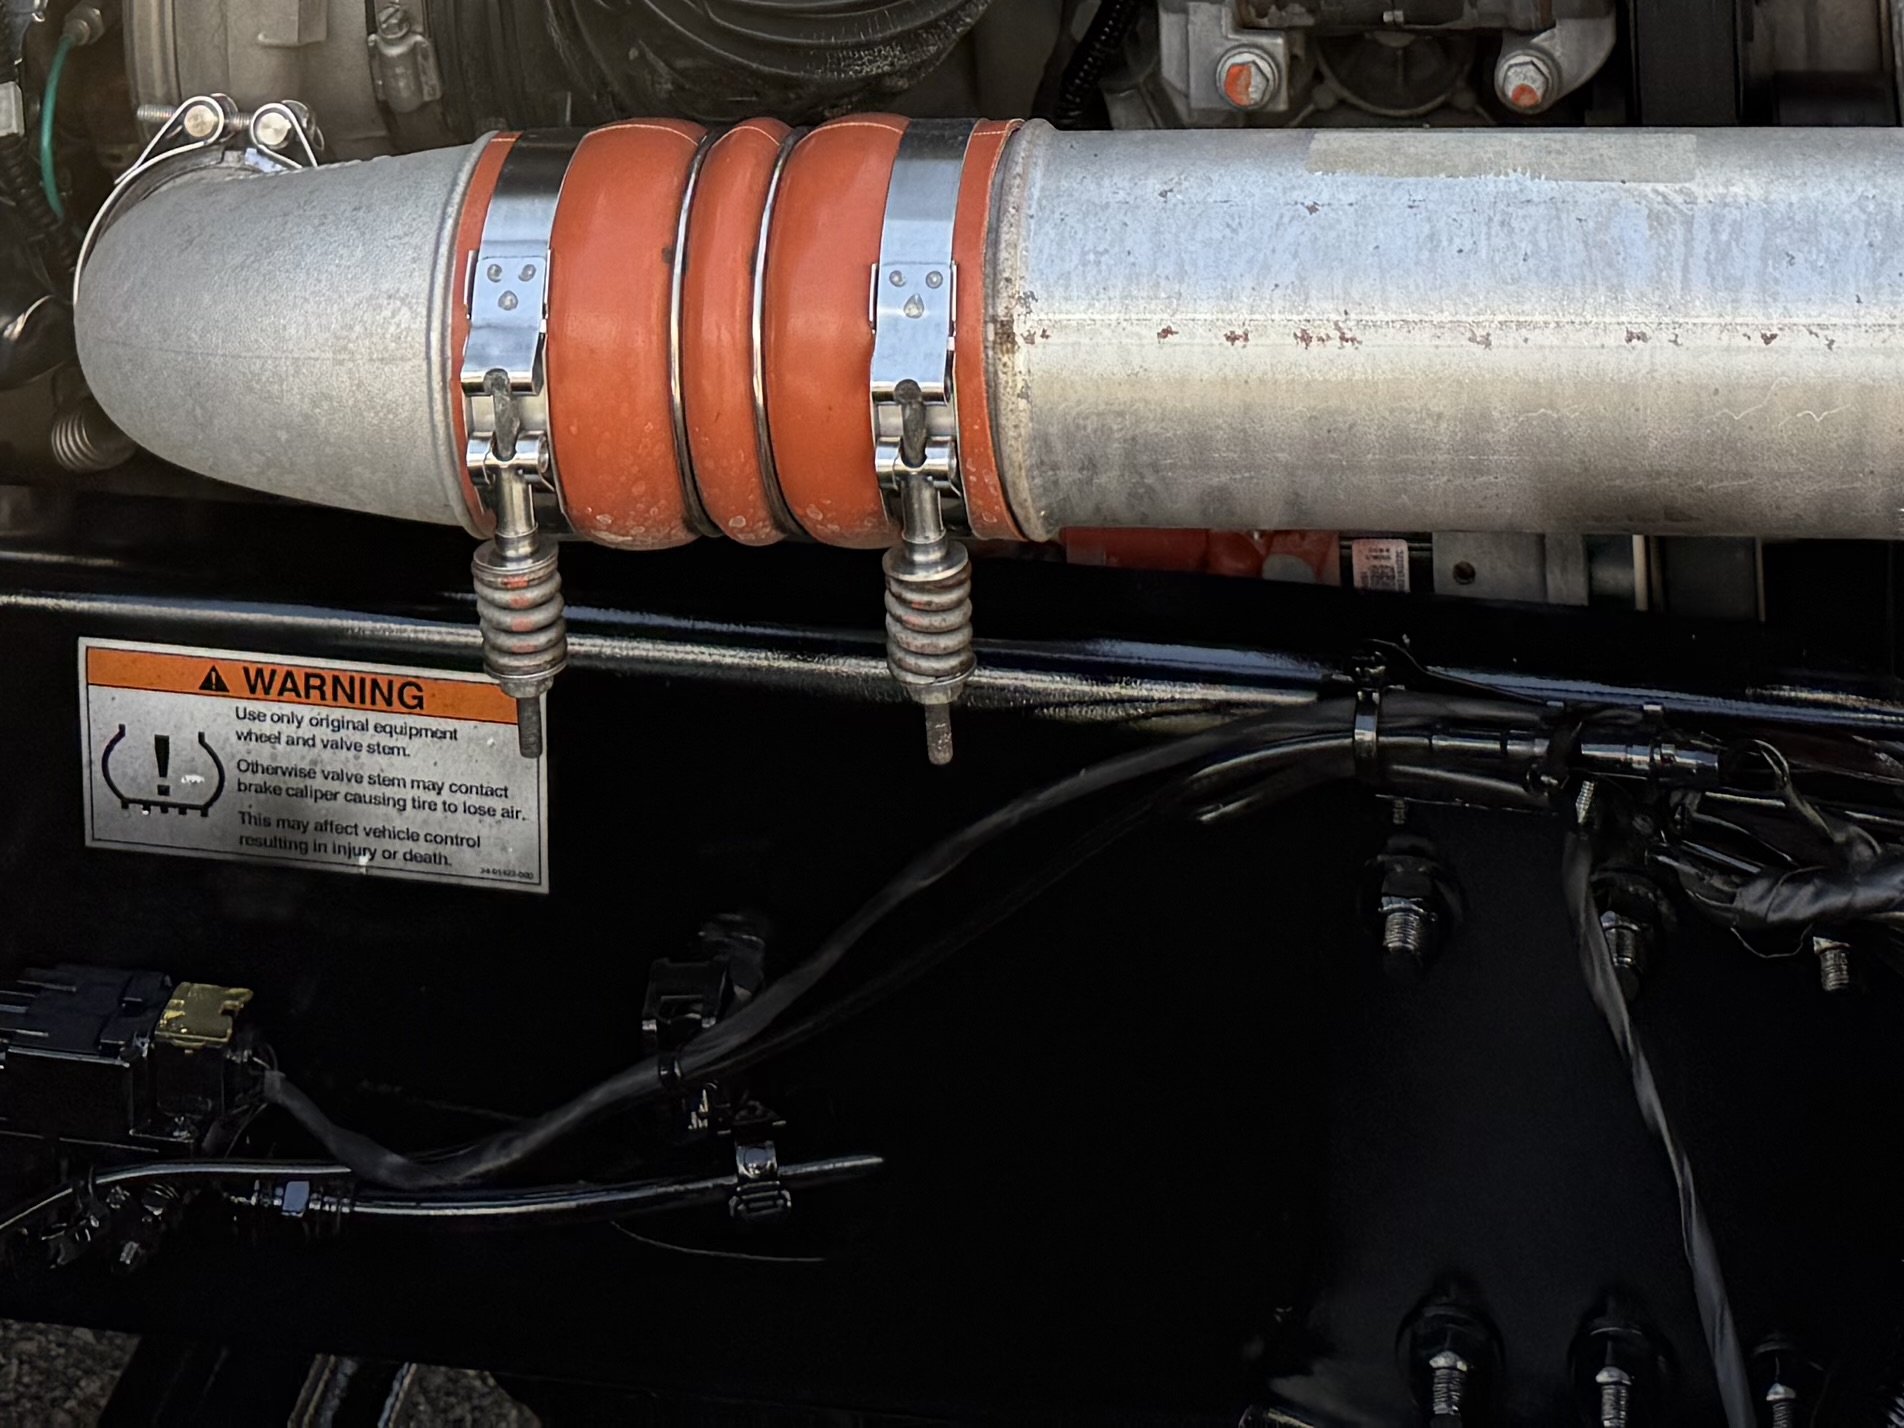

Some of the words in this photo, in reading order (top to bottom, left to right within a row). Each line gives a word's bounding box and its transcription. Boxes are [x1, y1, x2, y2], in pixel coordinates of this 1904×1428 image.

[242, 667, 425, 711] WARNING
[235, 707, 267, 723] Use
[270, 710, 304, 729] only
[309, 711, 370, 734] original
[373, 719, 458, 743] equipment
[236, 729, 281, 745] wheel
[285, 731, 316, 748] and
[320, 735, 363, 752] valve
[366, 742, 410, 757] stem.
[236, 759, 317, 780] Otherwise
[321, 767, 363, 785] valve
[367, 770, 407, 788] stem
[410, 778, 445, 795] may
[448, 780, 508, 798] contact
[237, 780, 282, 797] brake
[285, 784, 342, 807] caliper
[344, 789, 407, 812] causing
[411, 795, 438, 811] tire
[442, 800, 459, 813] to
[462, 800, 497, 817] lose
[500, 804, 526, 820] air.
[239, 812, 271, 828] This
[275, 817, 309, 835] may
[313, 818, 359, 837] affect
[363, 823, 420, 842] vehicle
[423, 830, 480, 848] control
[239, 833, 308, 856] resulting
[313, 839, 327, 854] in
[332, 841, 377, 863] injury
[382, 847, 398, 861] or
[401, 848, 452, 866] death.
